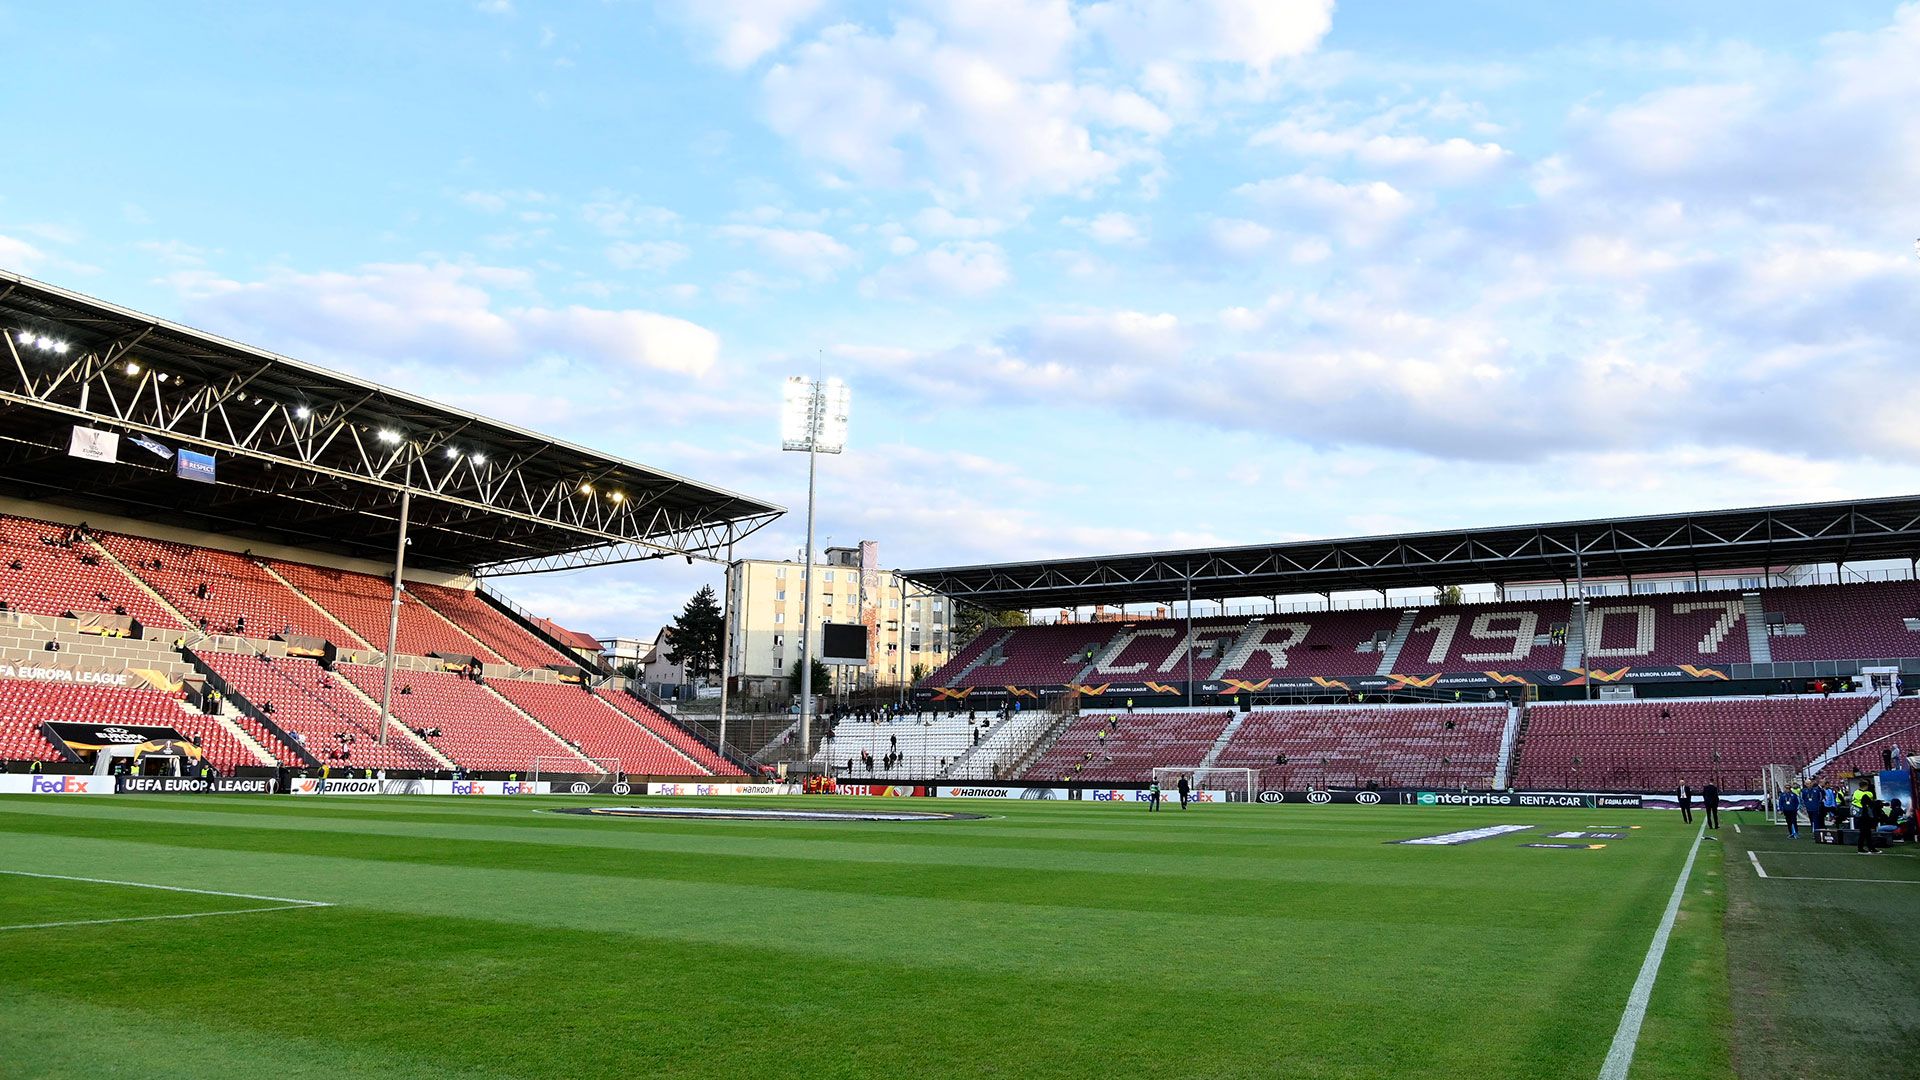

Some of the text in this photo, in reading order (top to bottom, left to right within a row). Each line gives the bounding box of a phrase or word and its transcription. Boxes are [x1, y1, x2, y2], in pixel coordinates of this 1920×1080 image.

[189, 462, 214, 473] RESPECT
[1096, 600, 1745, 674] CFR 1907
[20, 668, 72, 682] EUROPA
[75, 671, 127, 686] LEAGUE
[32, 775, 88, 793] FedEx
[125, 779, 266, 792] UEFA EUROPA LEAGUE
[452, 781, 485, 794] FedEx
[502, 782, 533, 795] FedEx
[661, 784, 685, 796] FedEx
[697, 784, 719, 796] FedEx
[834, 784, 872, 796] MSTEL
[1093, 790, 1125, 801] FedEx
[1136, 790, 1168, 802] Fedx
[1187, 791, 1213, 802] edEx
[1421, 794, 1580, 807] enterprise RENT-A-CAR
